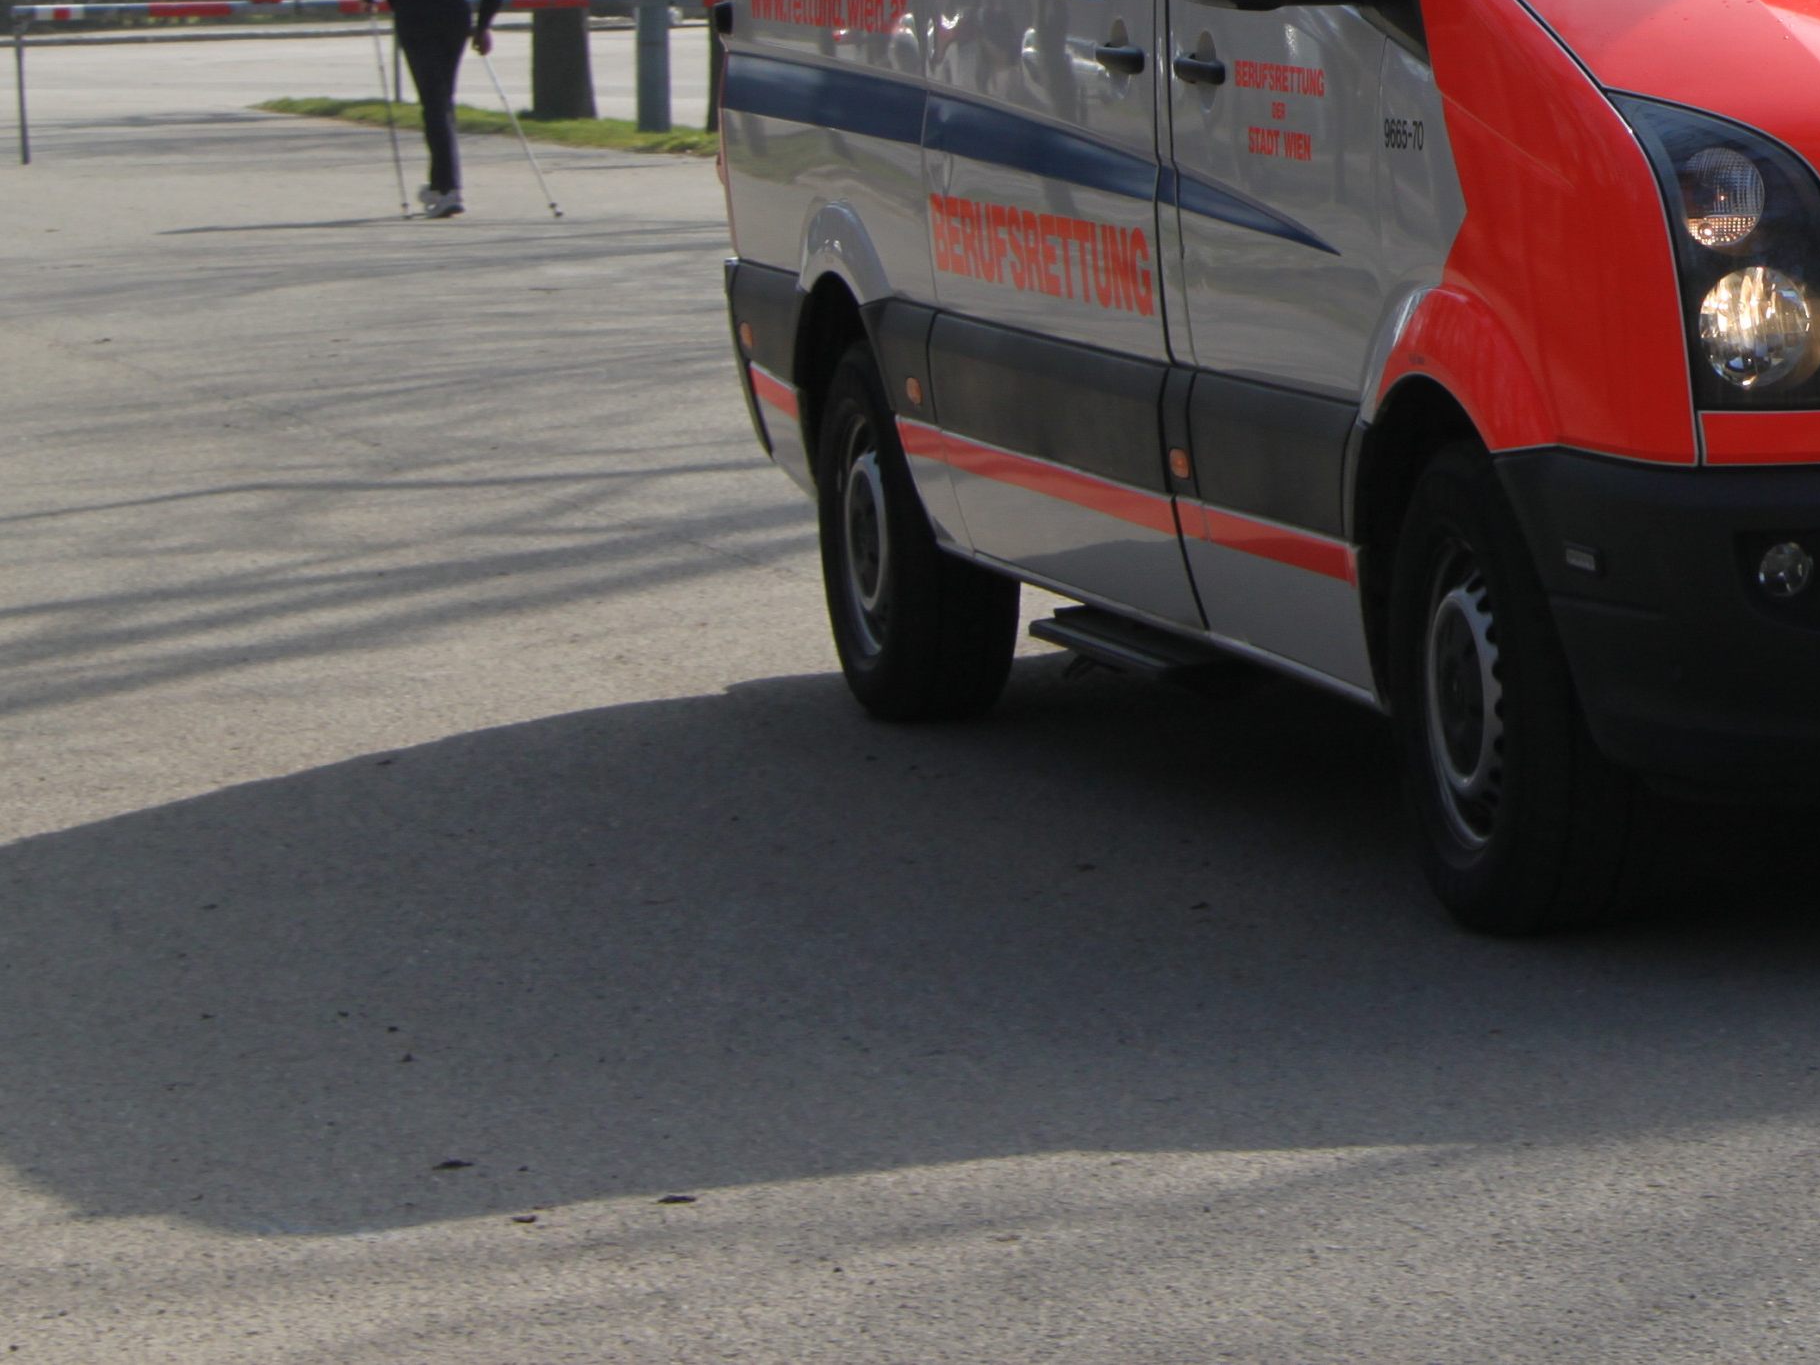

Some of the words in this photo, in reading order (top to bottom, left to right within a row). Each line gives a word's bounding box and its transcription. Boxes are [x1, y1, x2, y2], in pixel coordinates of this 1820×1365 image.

[1234, 60, 1325, 97] BERUFSRETTUNG
[1248, 126, 1281, 156] STADT
[1284, 129, 1312, 161] WIEN
[929, 193, 1155, 316] BERUFSRETTUNG
